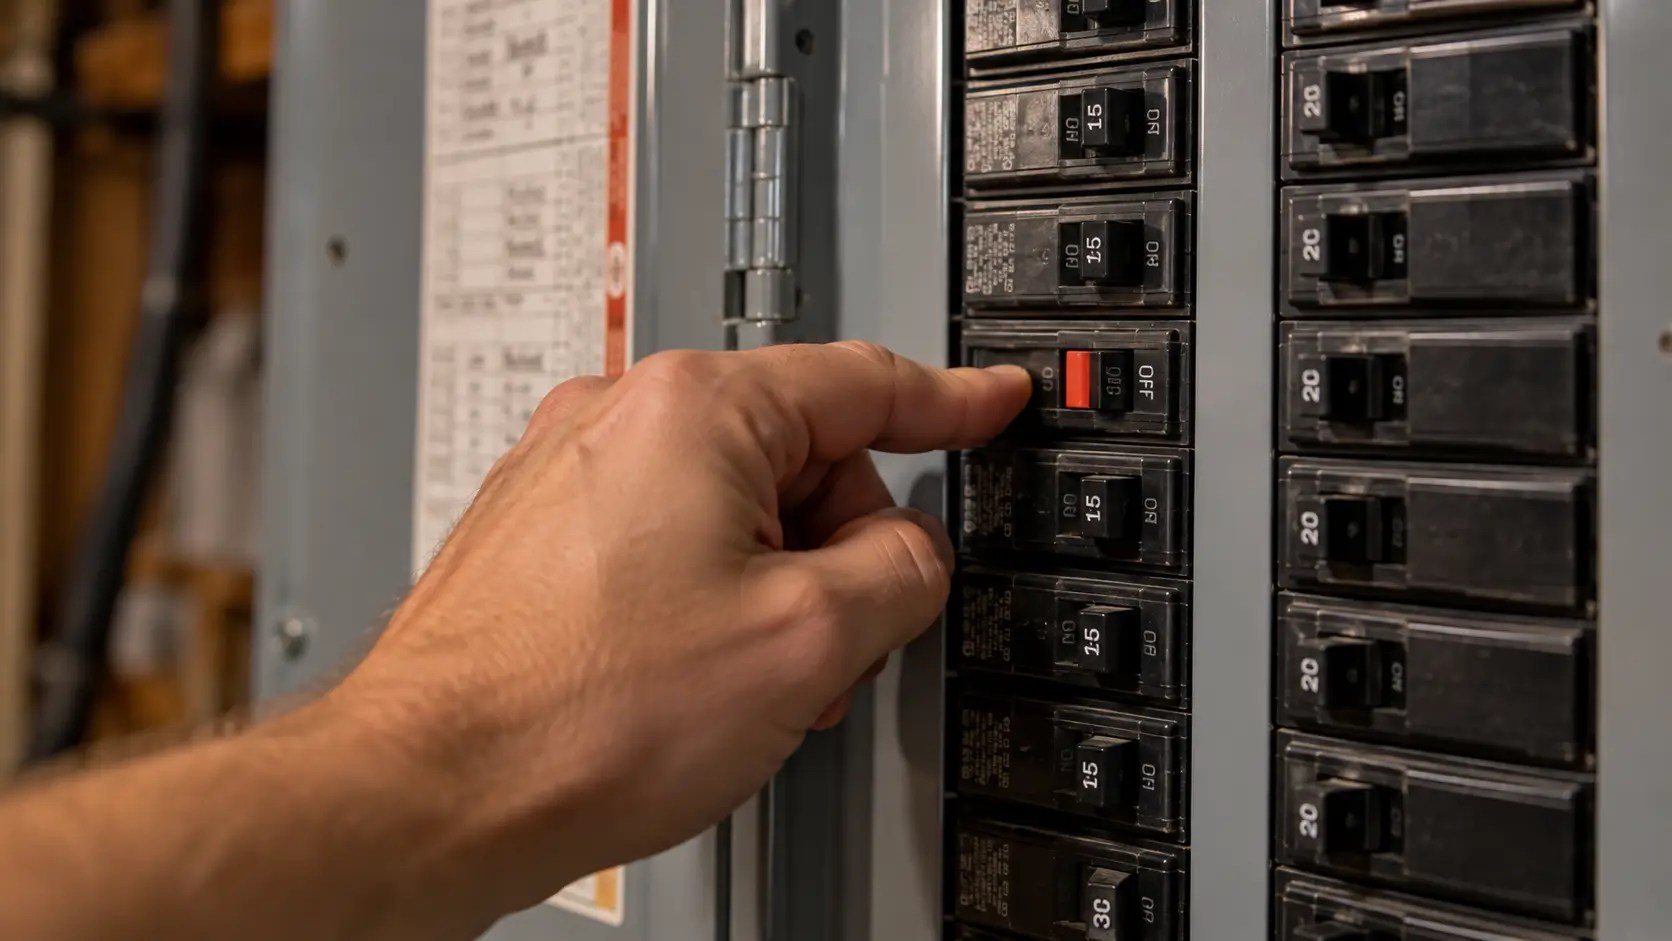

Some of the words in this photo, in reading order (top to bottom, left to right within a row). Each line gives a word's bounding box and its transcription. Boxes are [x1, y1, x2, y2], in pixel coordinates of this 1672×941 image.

[1087, 103, 1102, 131] 15
[1303, 84, 1321, 117] 20
[1138, 365, 1154, 400] OFF
[1302, 369, 1320, 402] 20
[1300, 511, 1319, 545] 20
[1300, 657, 1319, 693] 20
[1299, 803, 1318, 838] 20
